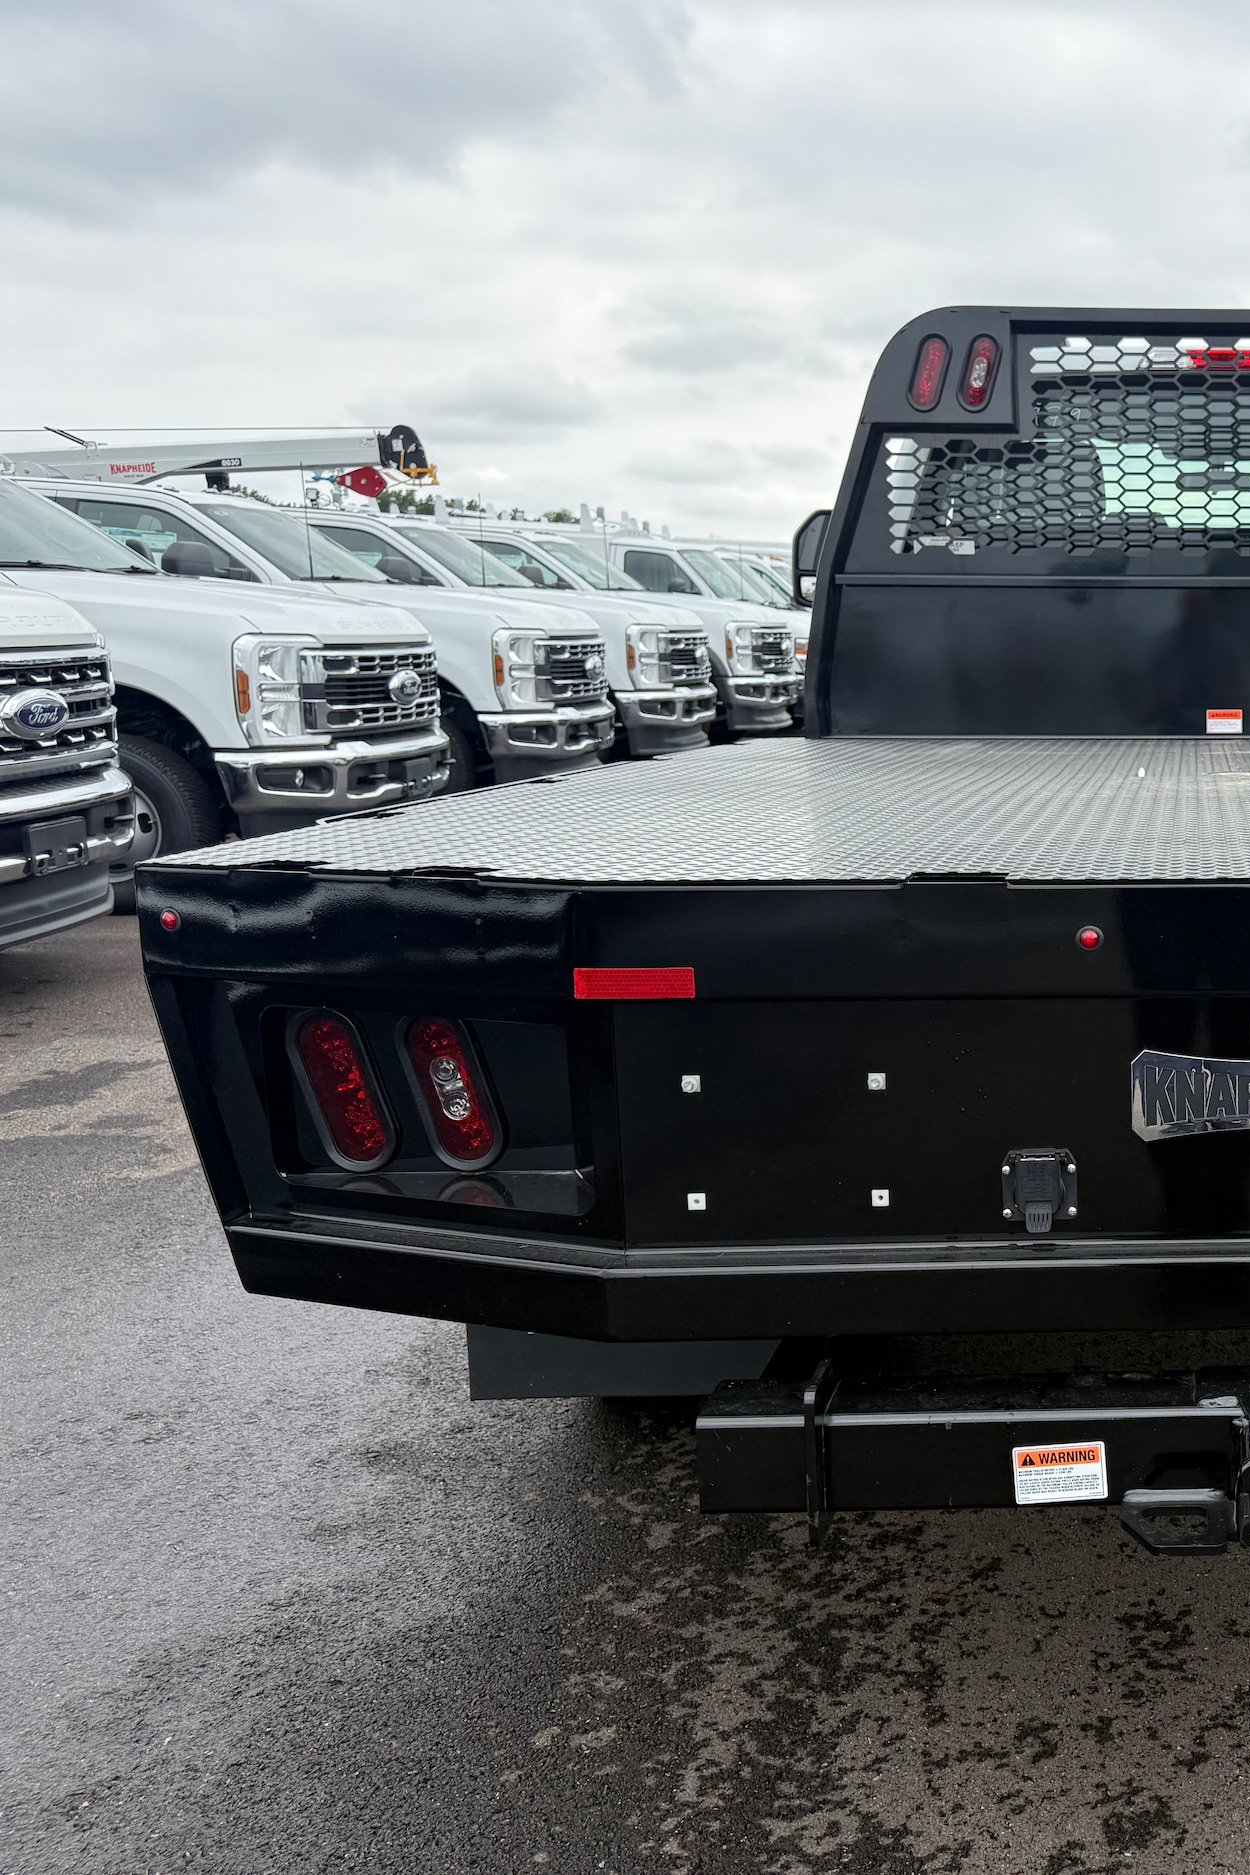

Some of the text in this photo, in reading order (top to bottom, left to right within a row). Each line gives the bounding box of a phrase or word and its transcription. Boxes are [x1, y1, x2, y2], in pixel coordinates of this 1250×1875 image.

[110, 462, 156, 475] KNAPHEIDE
[28, 703, 59, 724] Ford
[1038, 1449, 1095, 1465] WARNING
